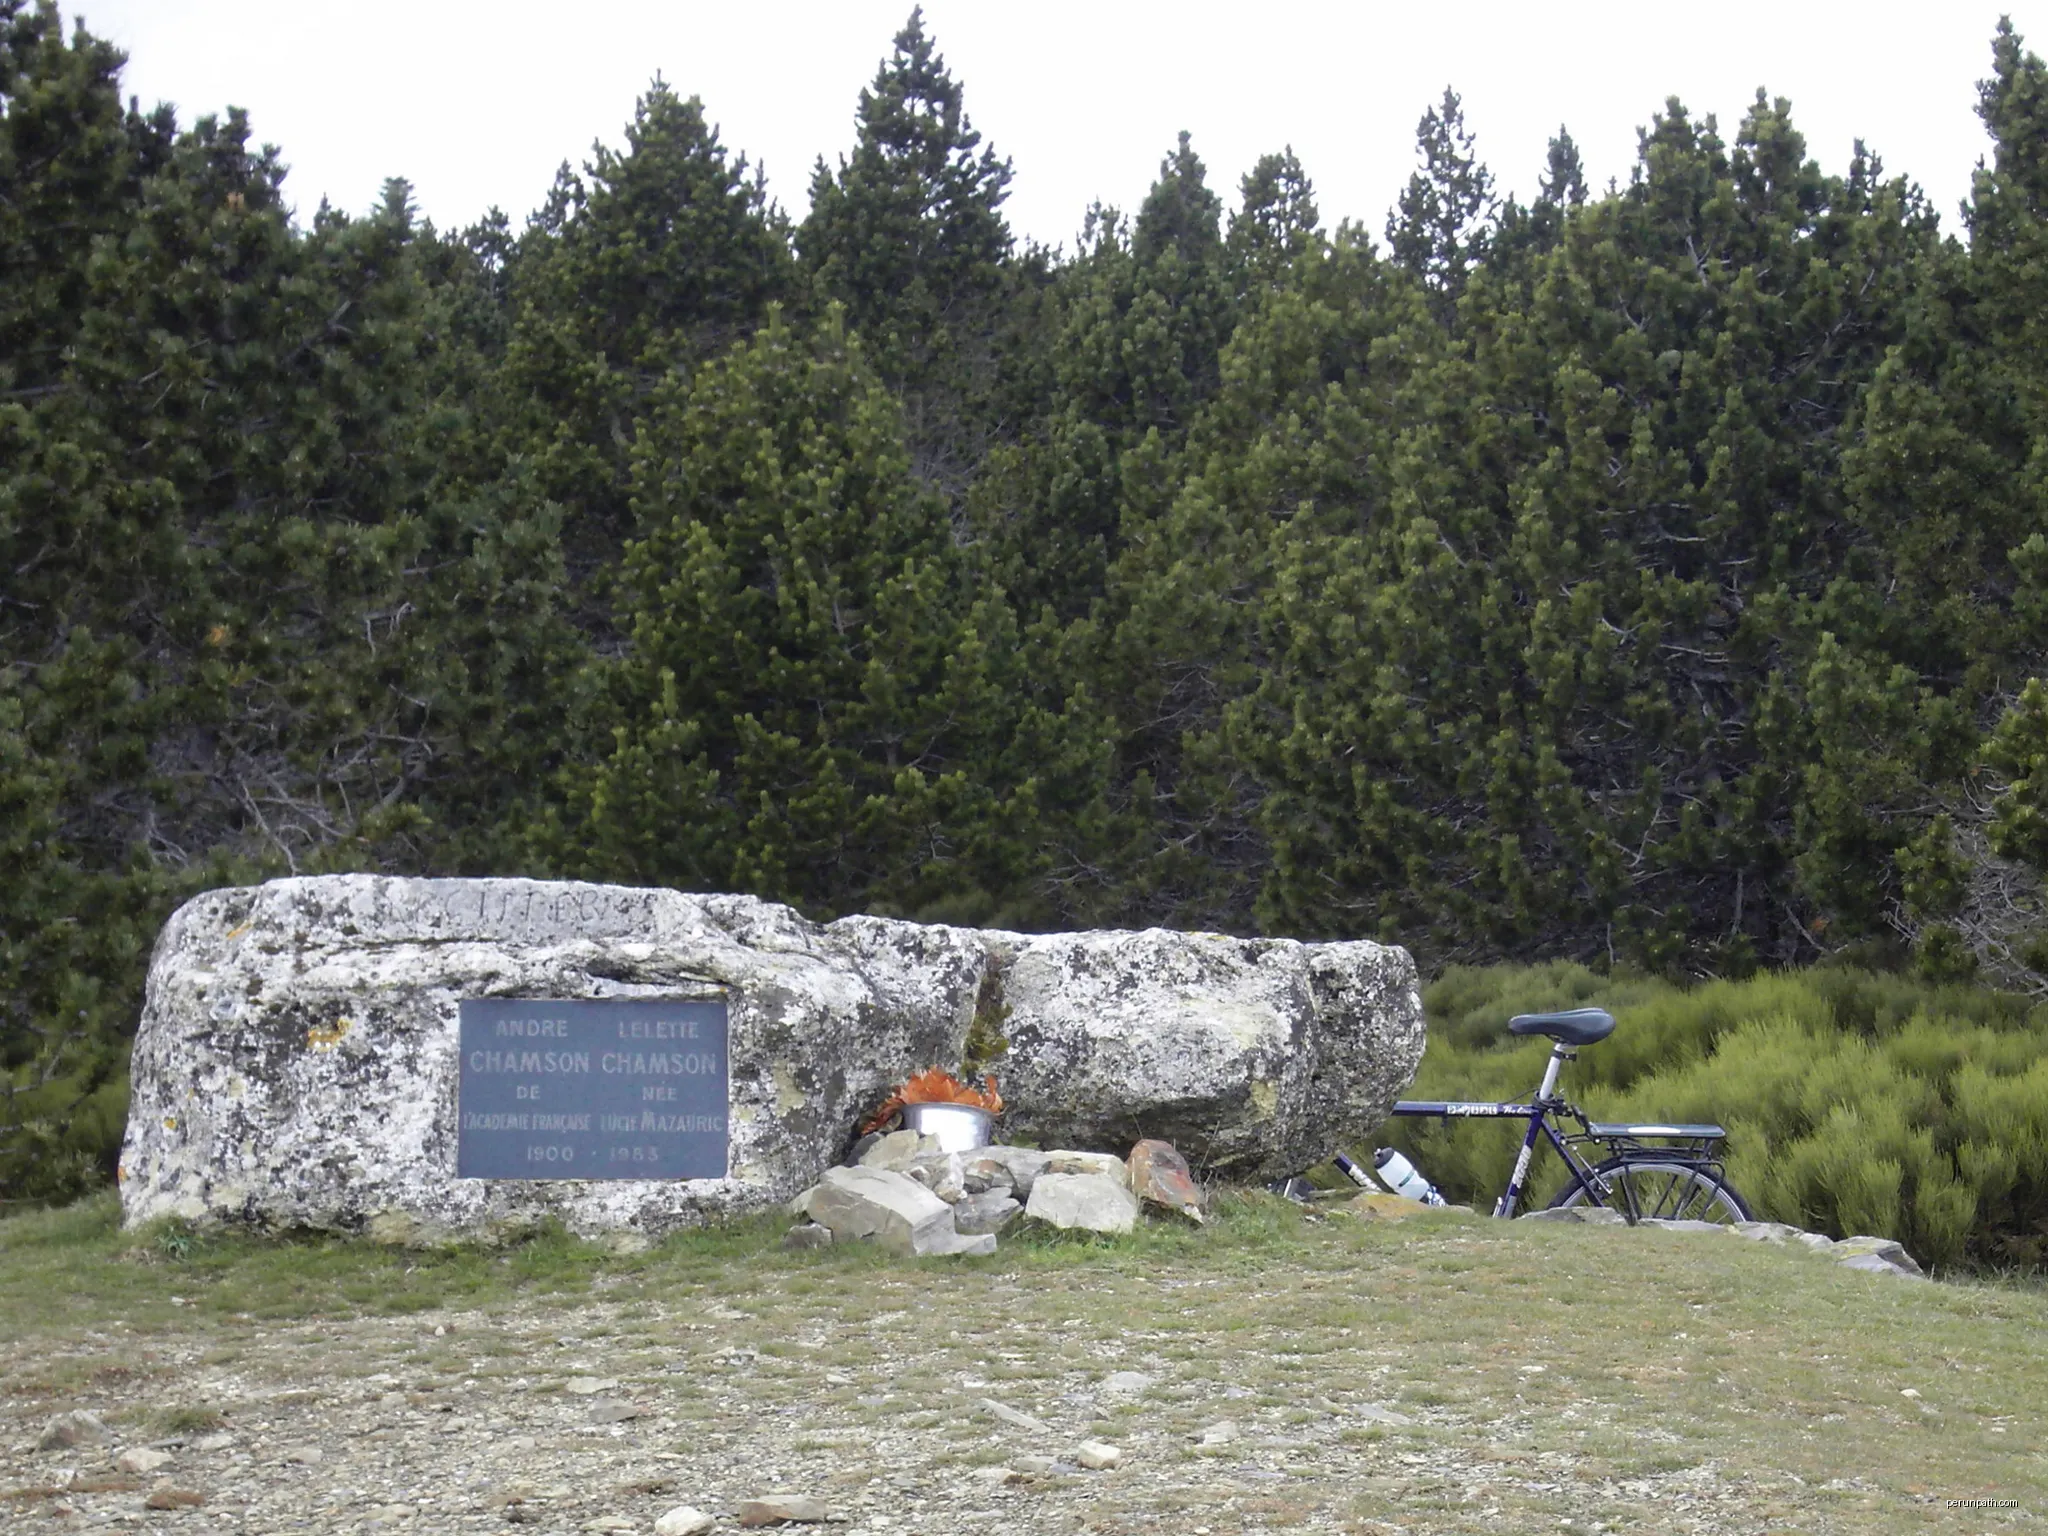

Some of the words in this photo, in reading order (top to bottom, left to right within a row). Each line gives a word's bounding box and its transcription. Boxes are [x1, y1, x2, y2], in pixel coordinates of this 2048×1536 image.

[496, 1019, 568, 1038] ANDRE
[618, 1020, 700, 1039] LELETTE
[469, 1050, 590, 1074] CHAMSON
[602, 1052, 717, 1075] CHAMSON
[516, 1085, 541, 1100] DE
[528, 1145, 575, 1162] 1900
